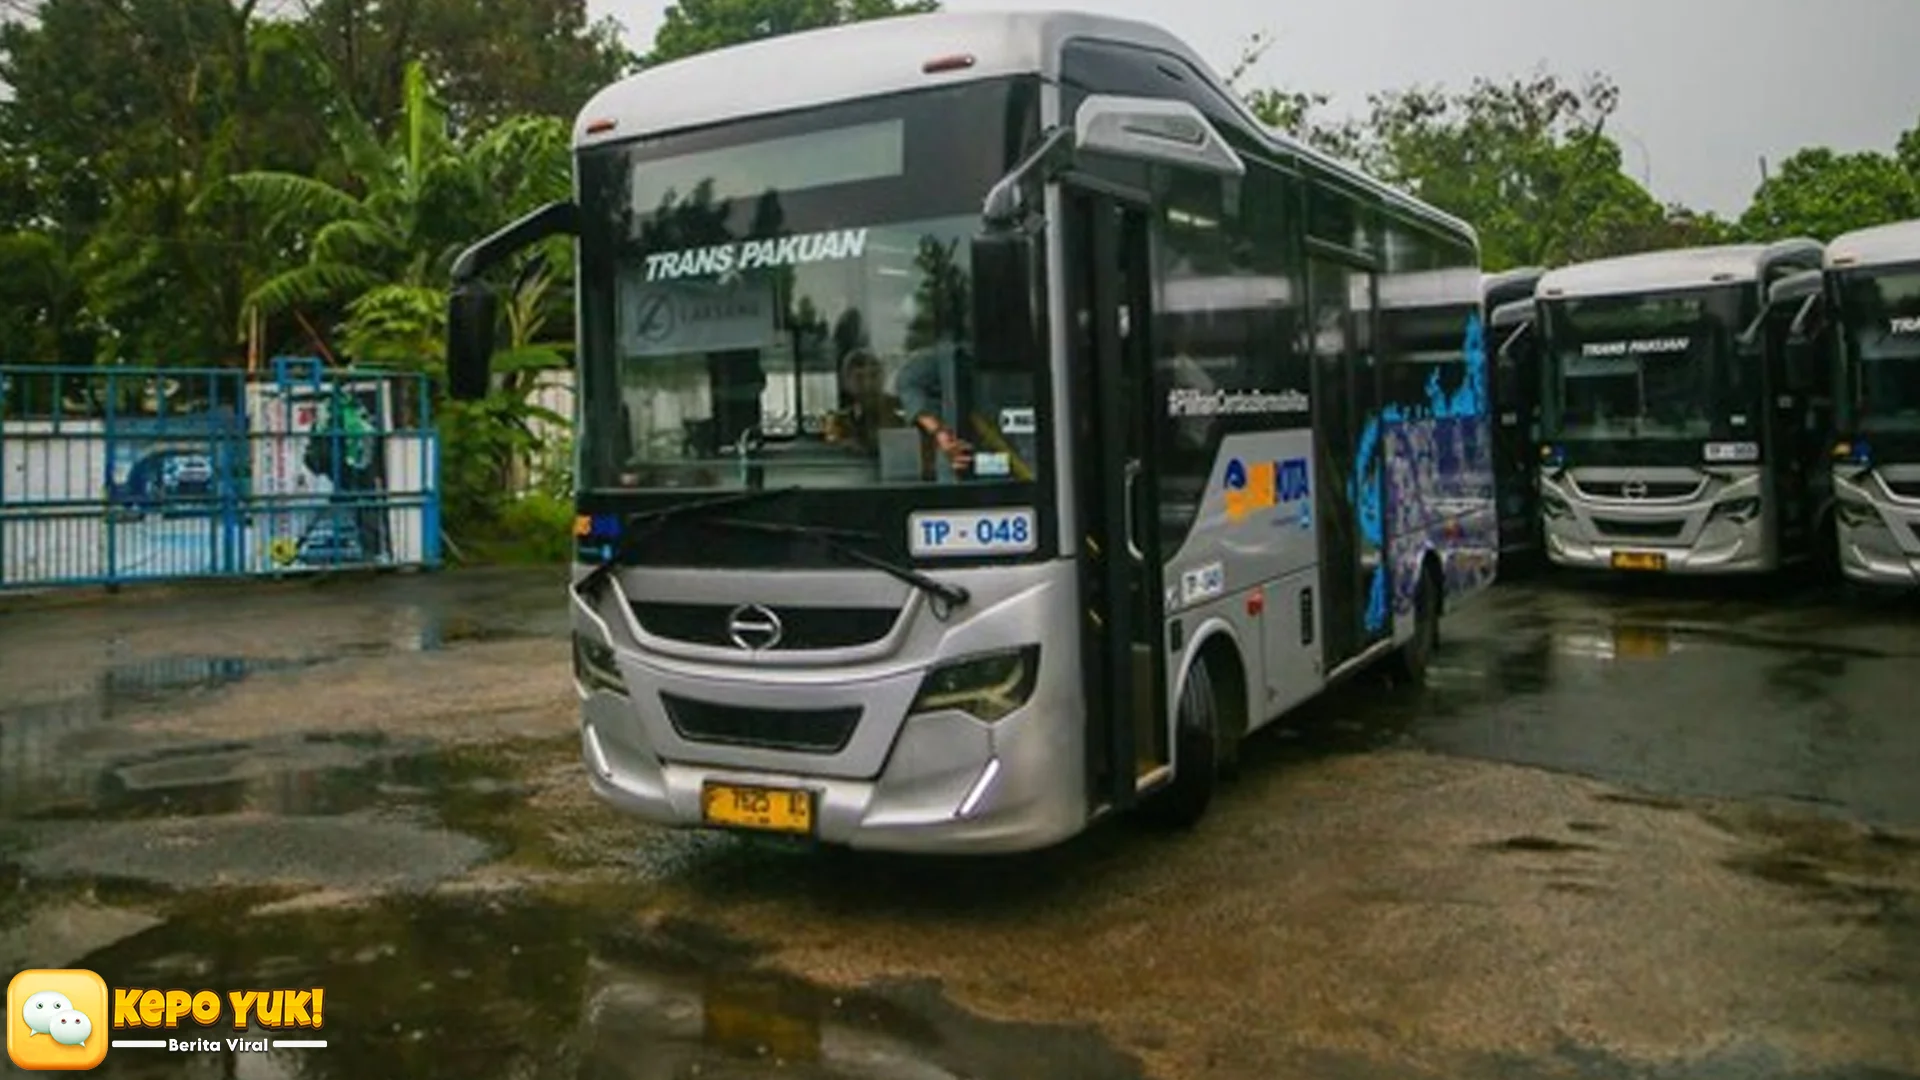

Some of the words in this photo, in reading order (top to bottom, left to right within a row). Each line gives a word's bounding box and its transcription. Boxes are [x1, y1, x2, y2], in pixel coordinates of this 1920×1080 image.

[644, 244, 734, 282] TRANS
[738, 227, 868, 270] PAKUAN
[1581, 341, 1627, 357] TRANS
[1628, 336, 1690, 354] PAKUAN
[919, 519, 951, 546] TP
[975, 516, 1029, 545] 048
